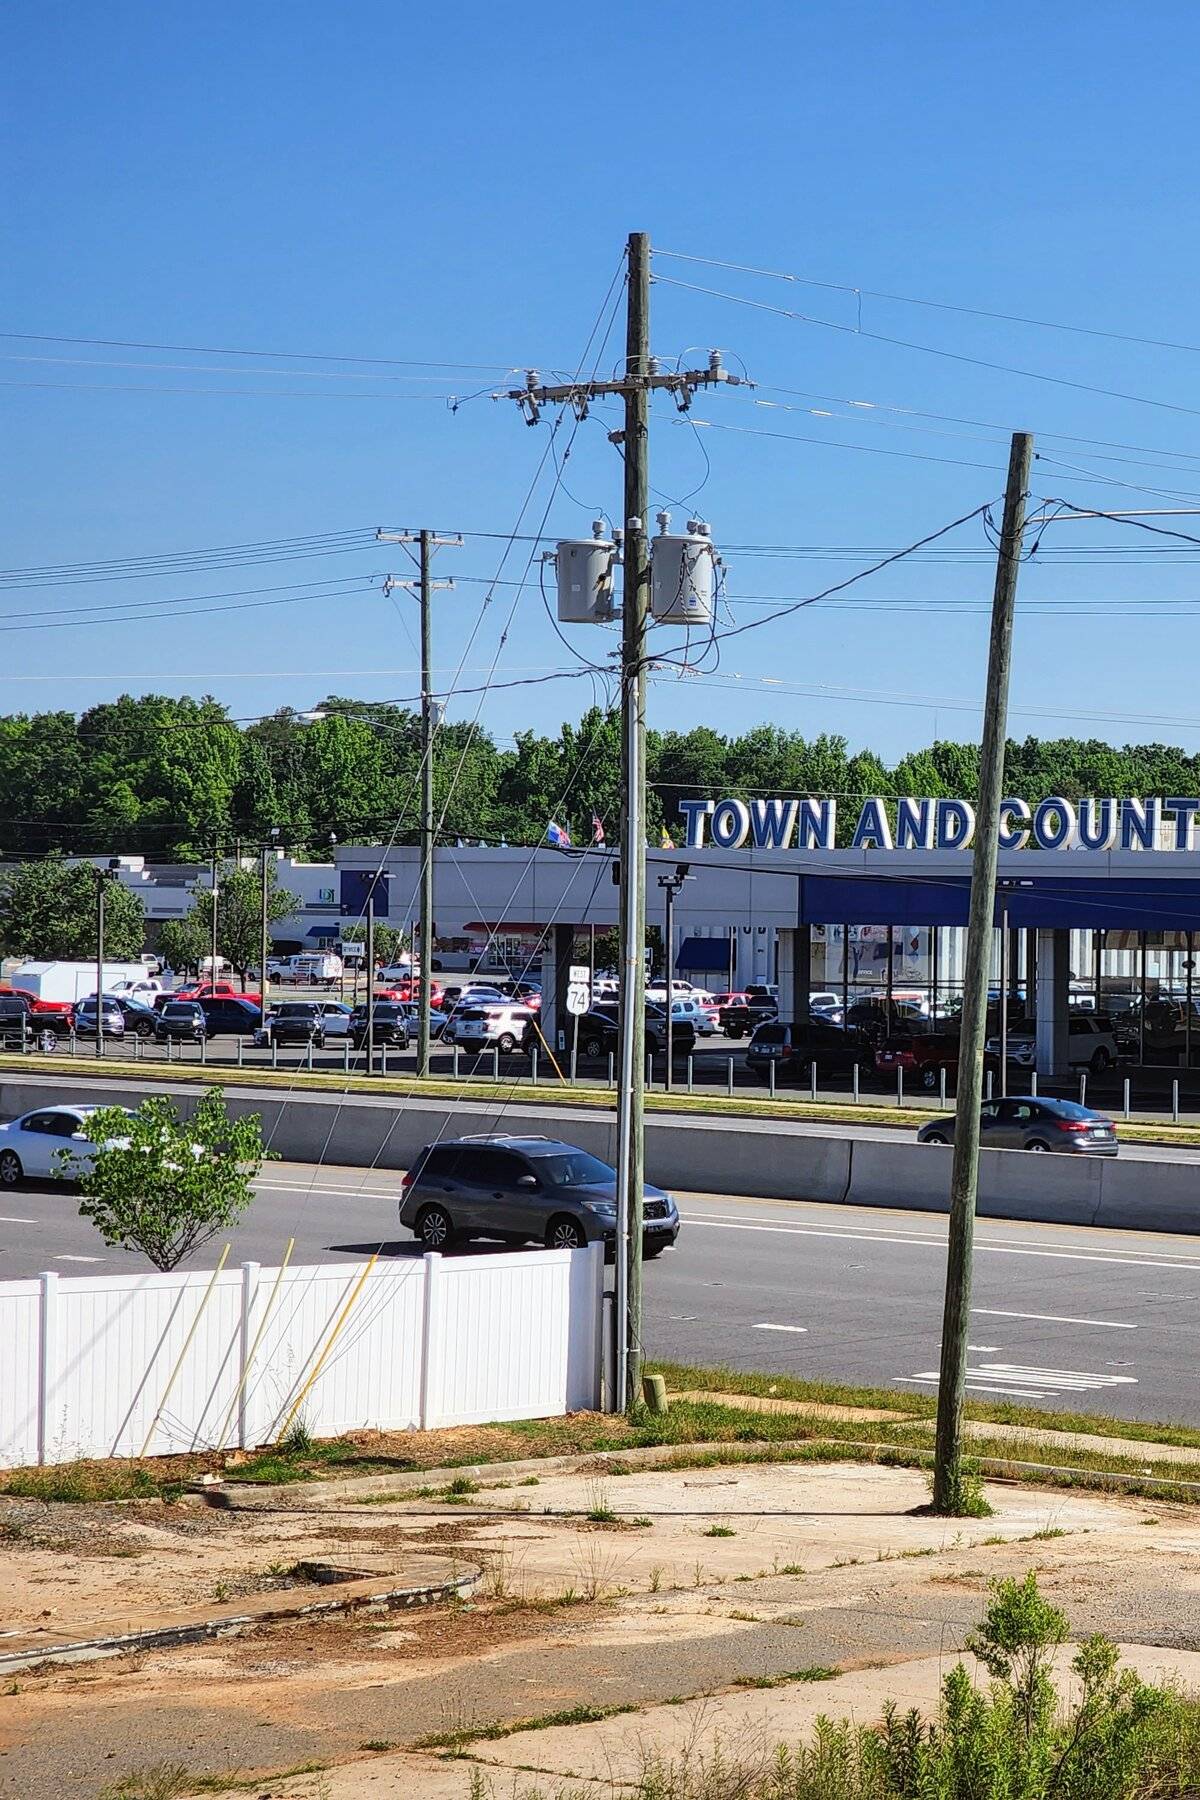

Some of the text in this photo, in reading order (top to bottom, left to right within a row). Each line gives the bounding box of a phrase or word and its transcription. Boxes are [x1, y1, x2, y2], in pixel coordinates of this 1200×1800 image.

[679, 798, 836, 850] TOWN
[852, 798, 976, 850] AND
[570, 991, 585, 1010] 74
